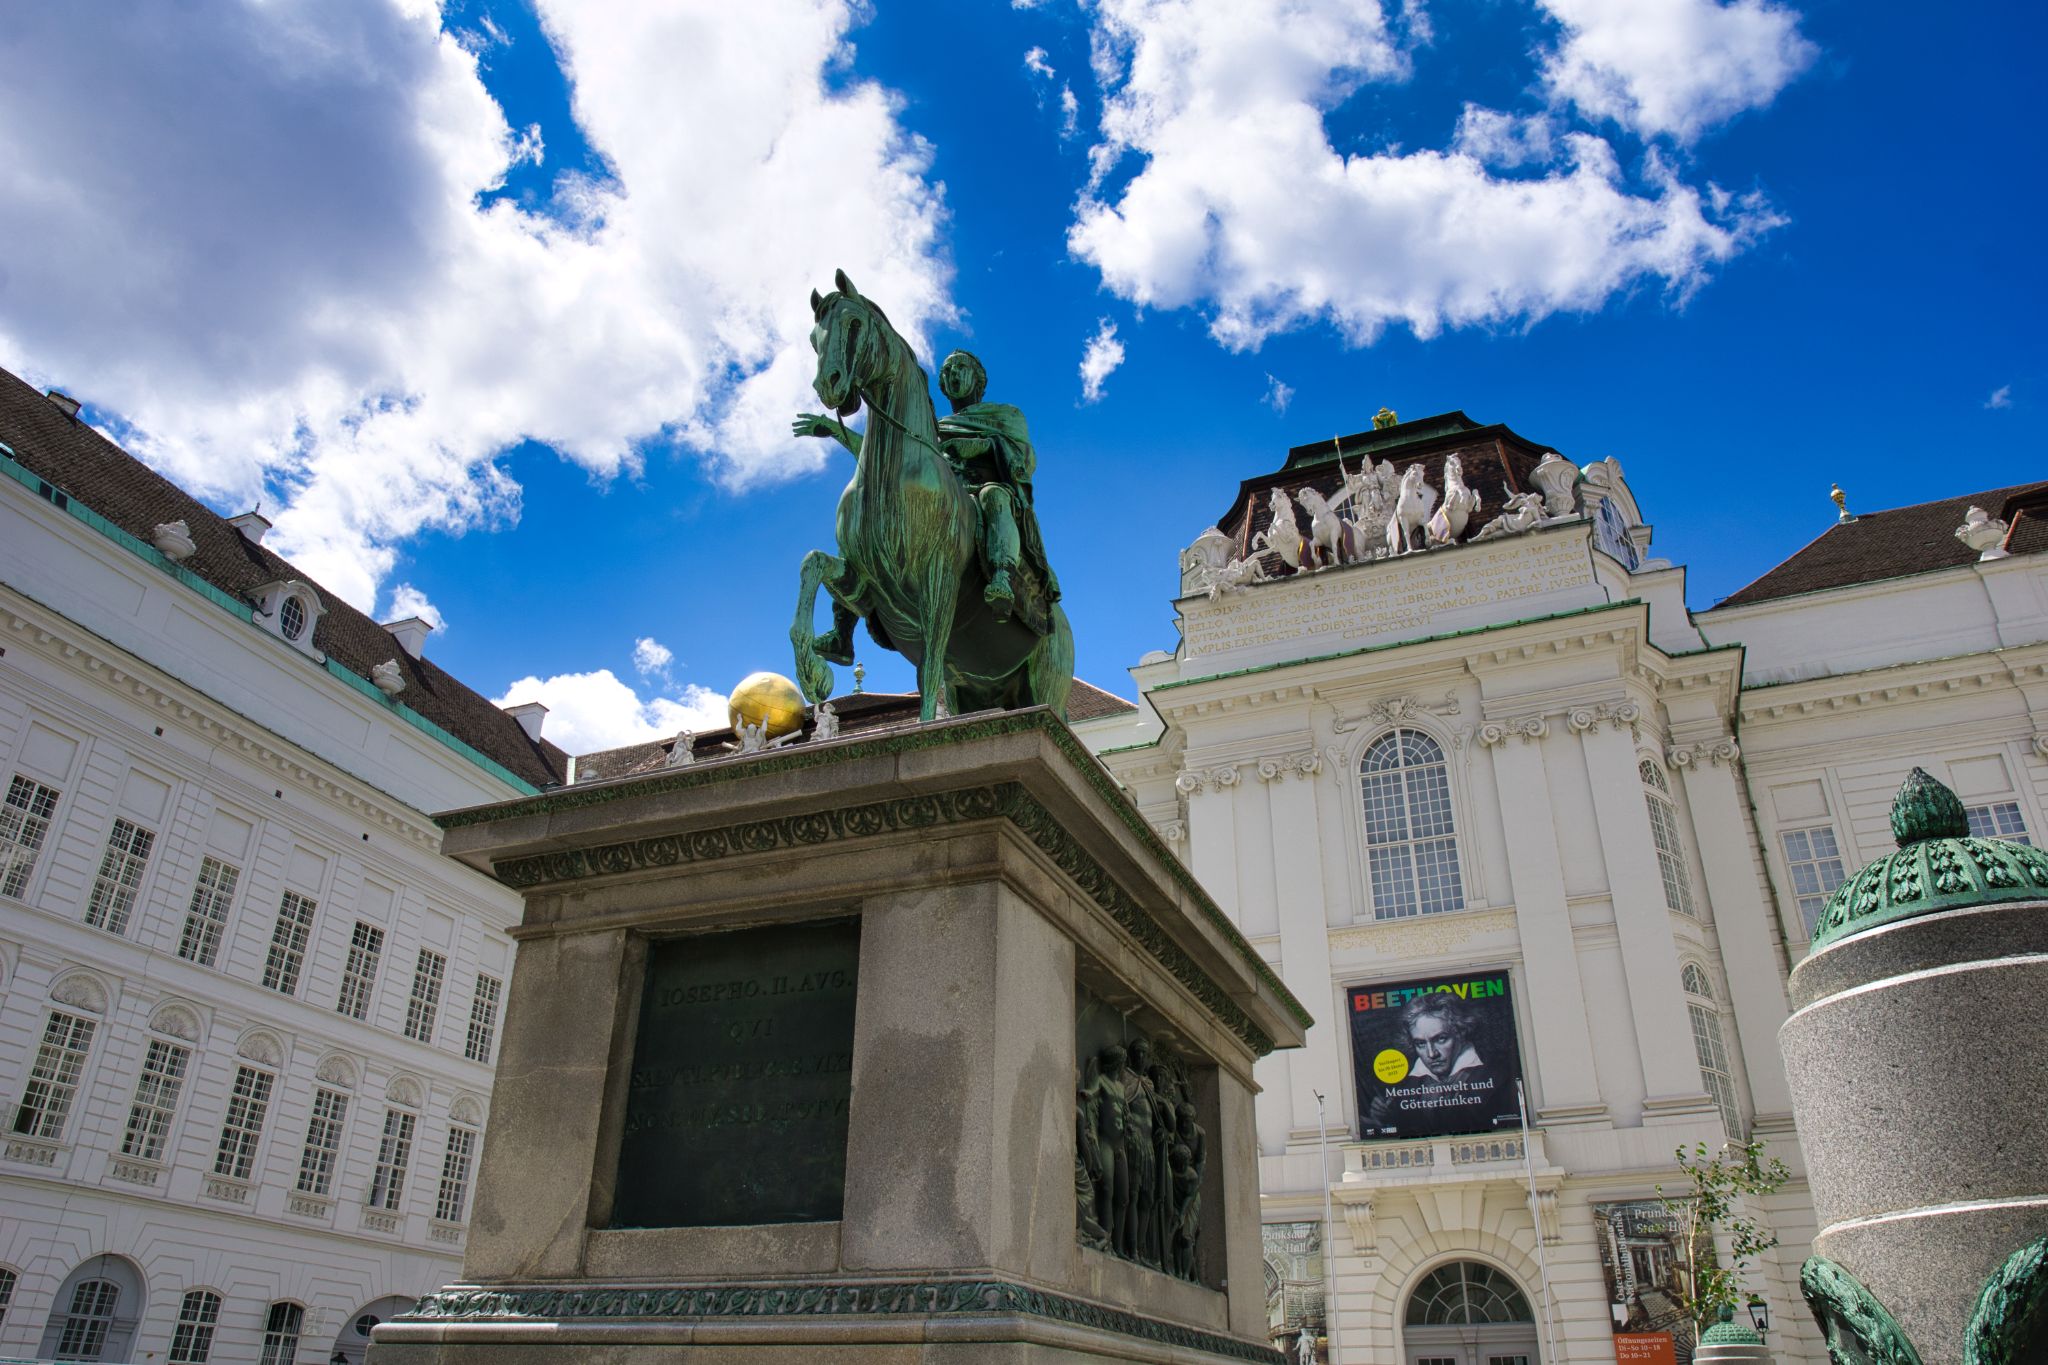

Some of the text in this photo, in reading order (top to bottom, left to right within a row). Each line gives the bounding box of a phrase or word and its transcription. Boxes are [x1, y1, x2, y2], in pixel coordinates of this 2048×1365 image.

[1353, 978, 1505, 1012] BEETHOVEN
[1385, 1078, 1494, 1098] Menschenwelt und
[1400, 1094, 1482, 1110] Götterfunken
[1634, 1205, 1688, 1219] Prunka
